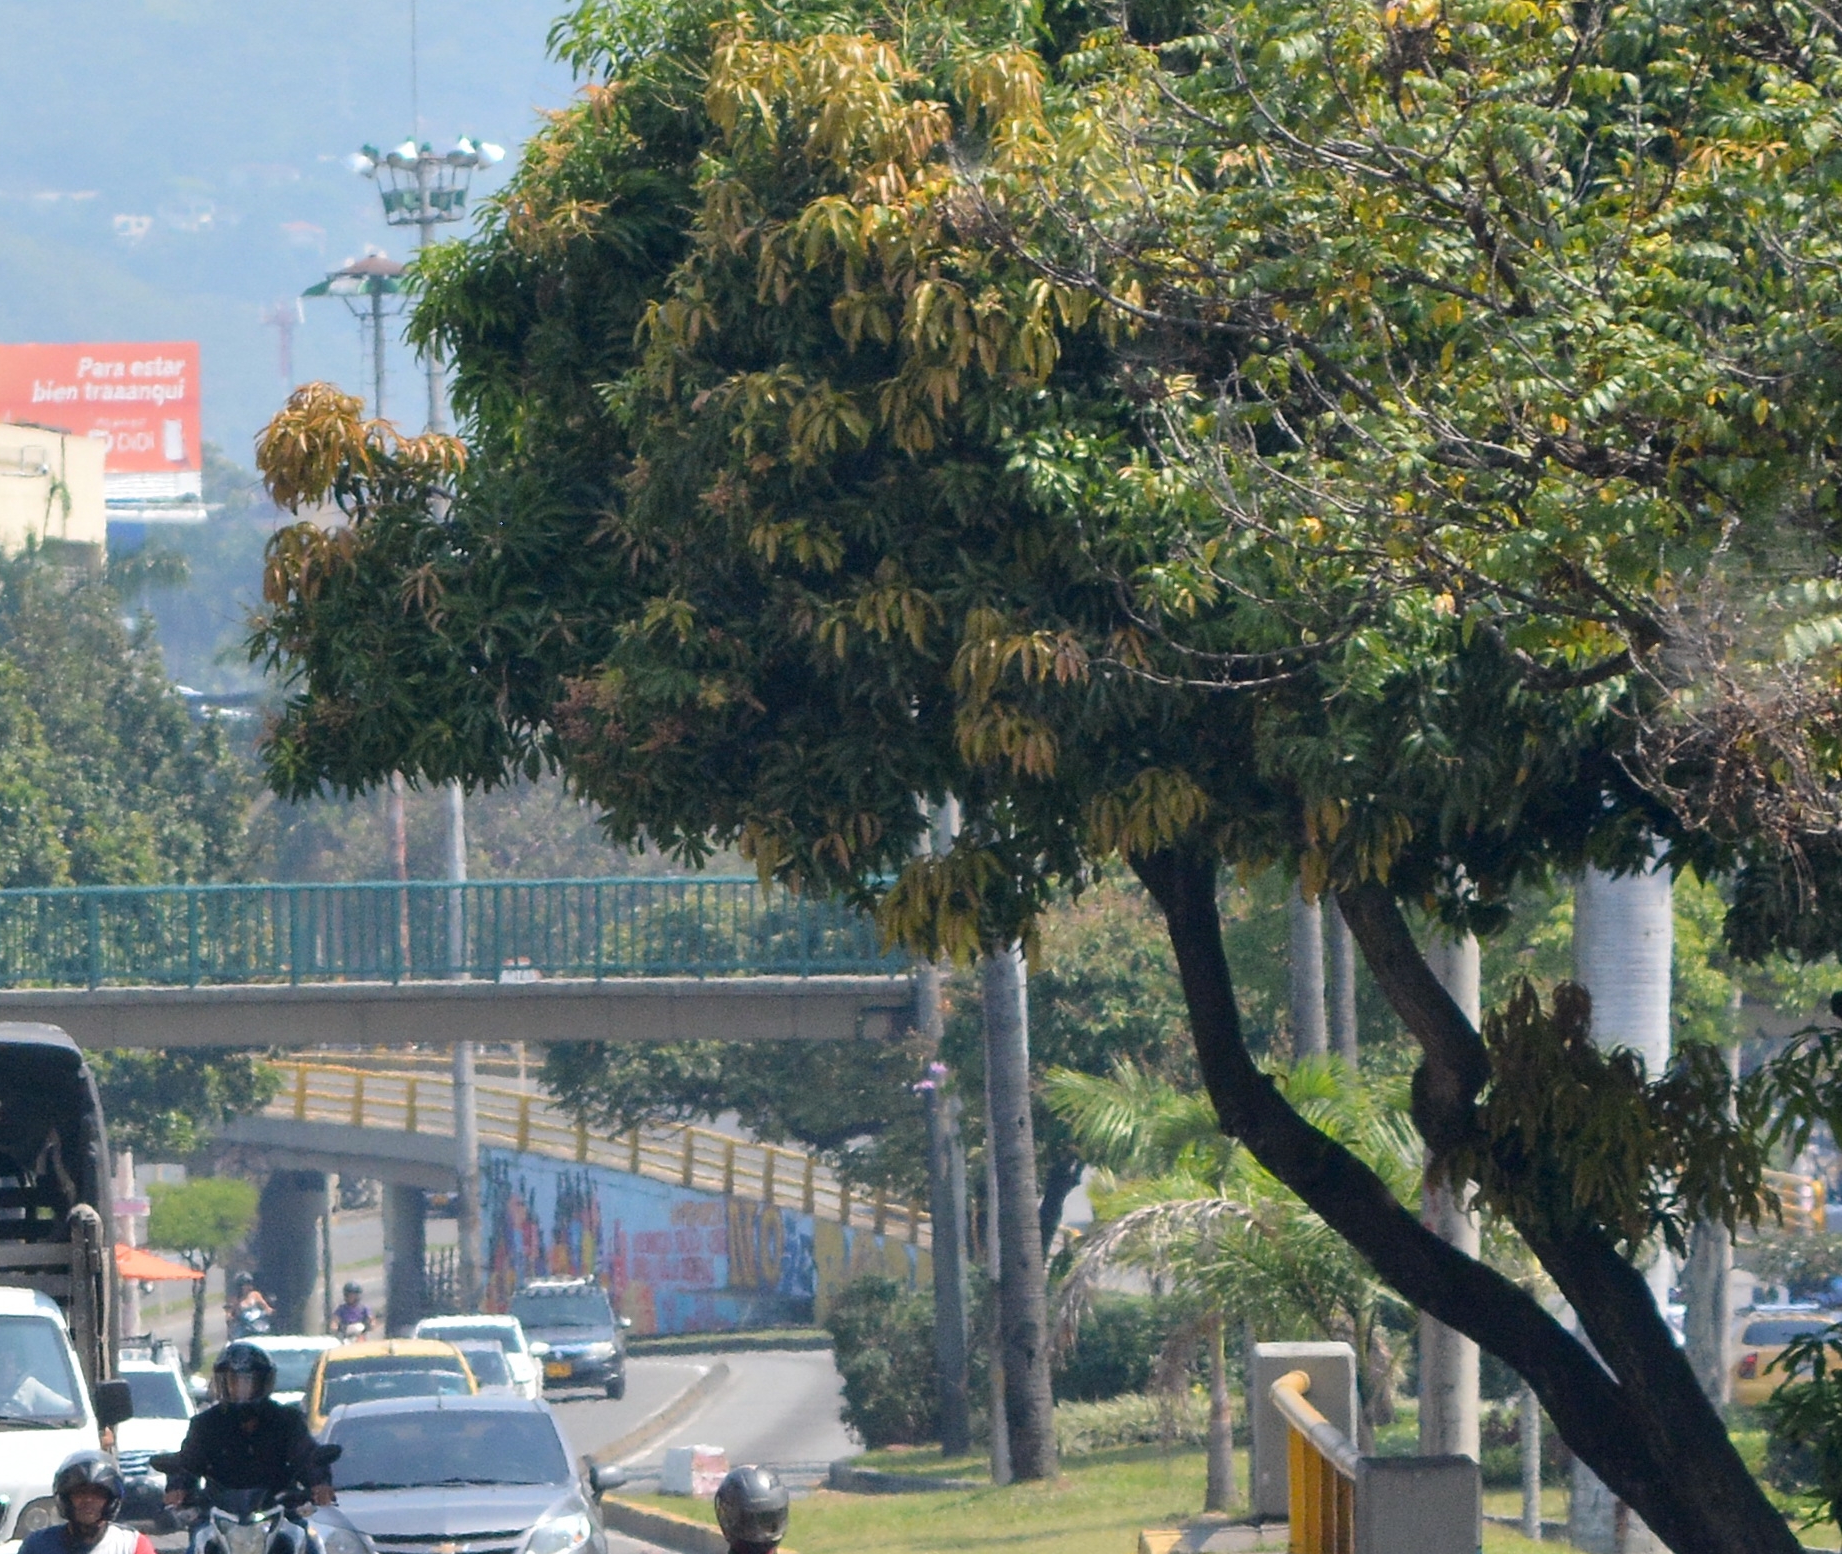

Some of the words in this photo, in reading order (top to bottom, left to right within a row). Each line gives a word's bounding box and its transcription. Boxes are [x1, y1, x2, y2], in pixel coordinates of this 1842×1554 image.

[77, 356, 126, 379] Para
[130, 356, 186, 378] estar
[32, 379, 79, 403] bien
[84, 377, 185, 407] traaanqui
